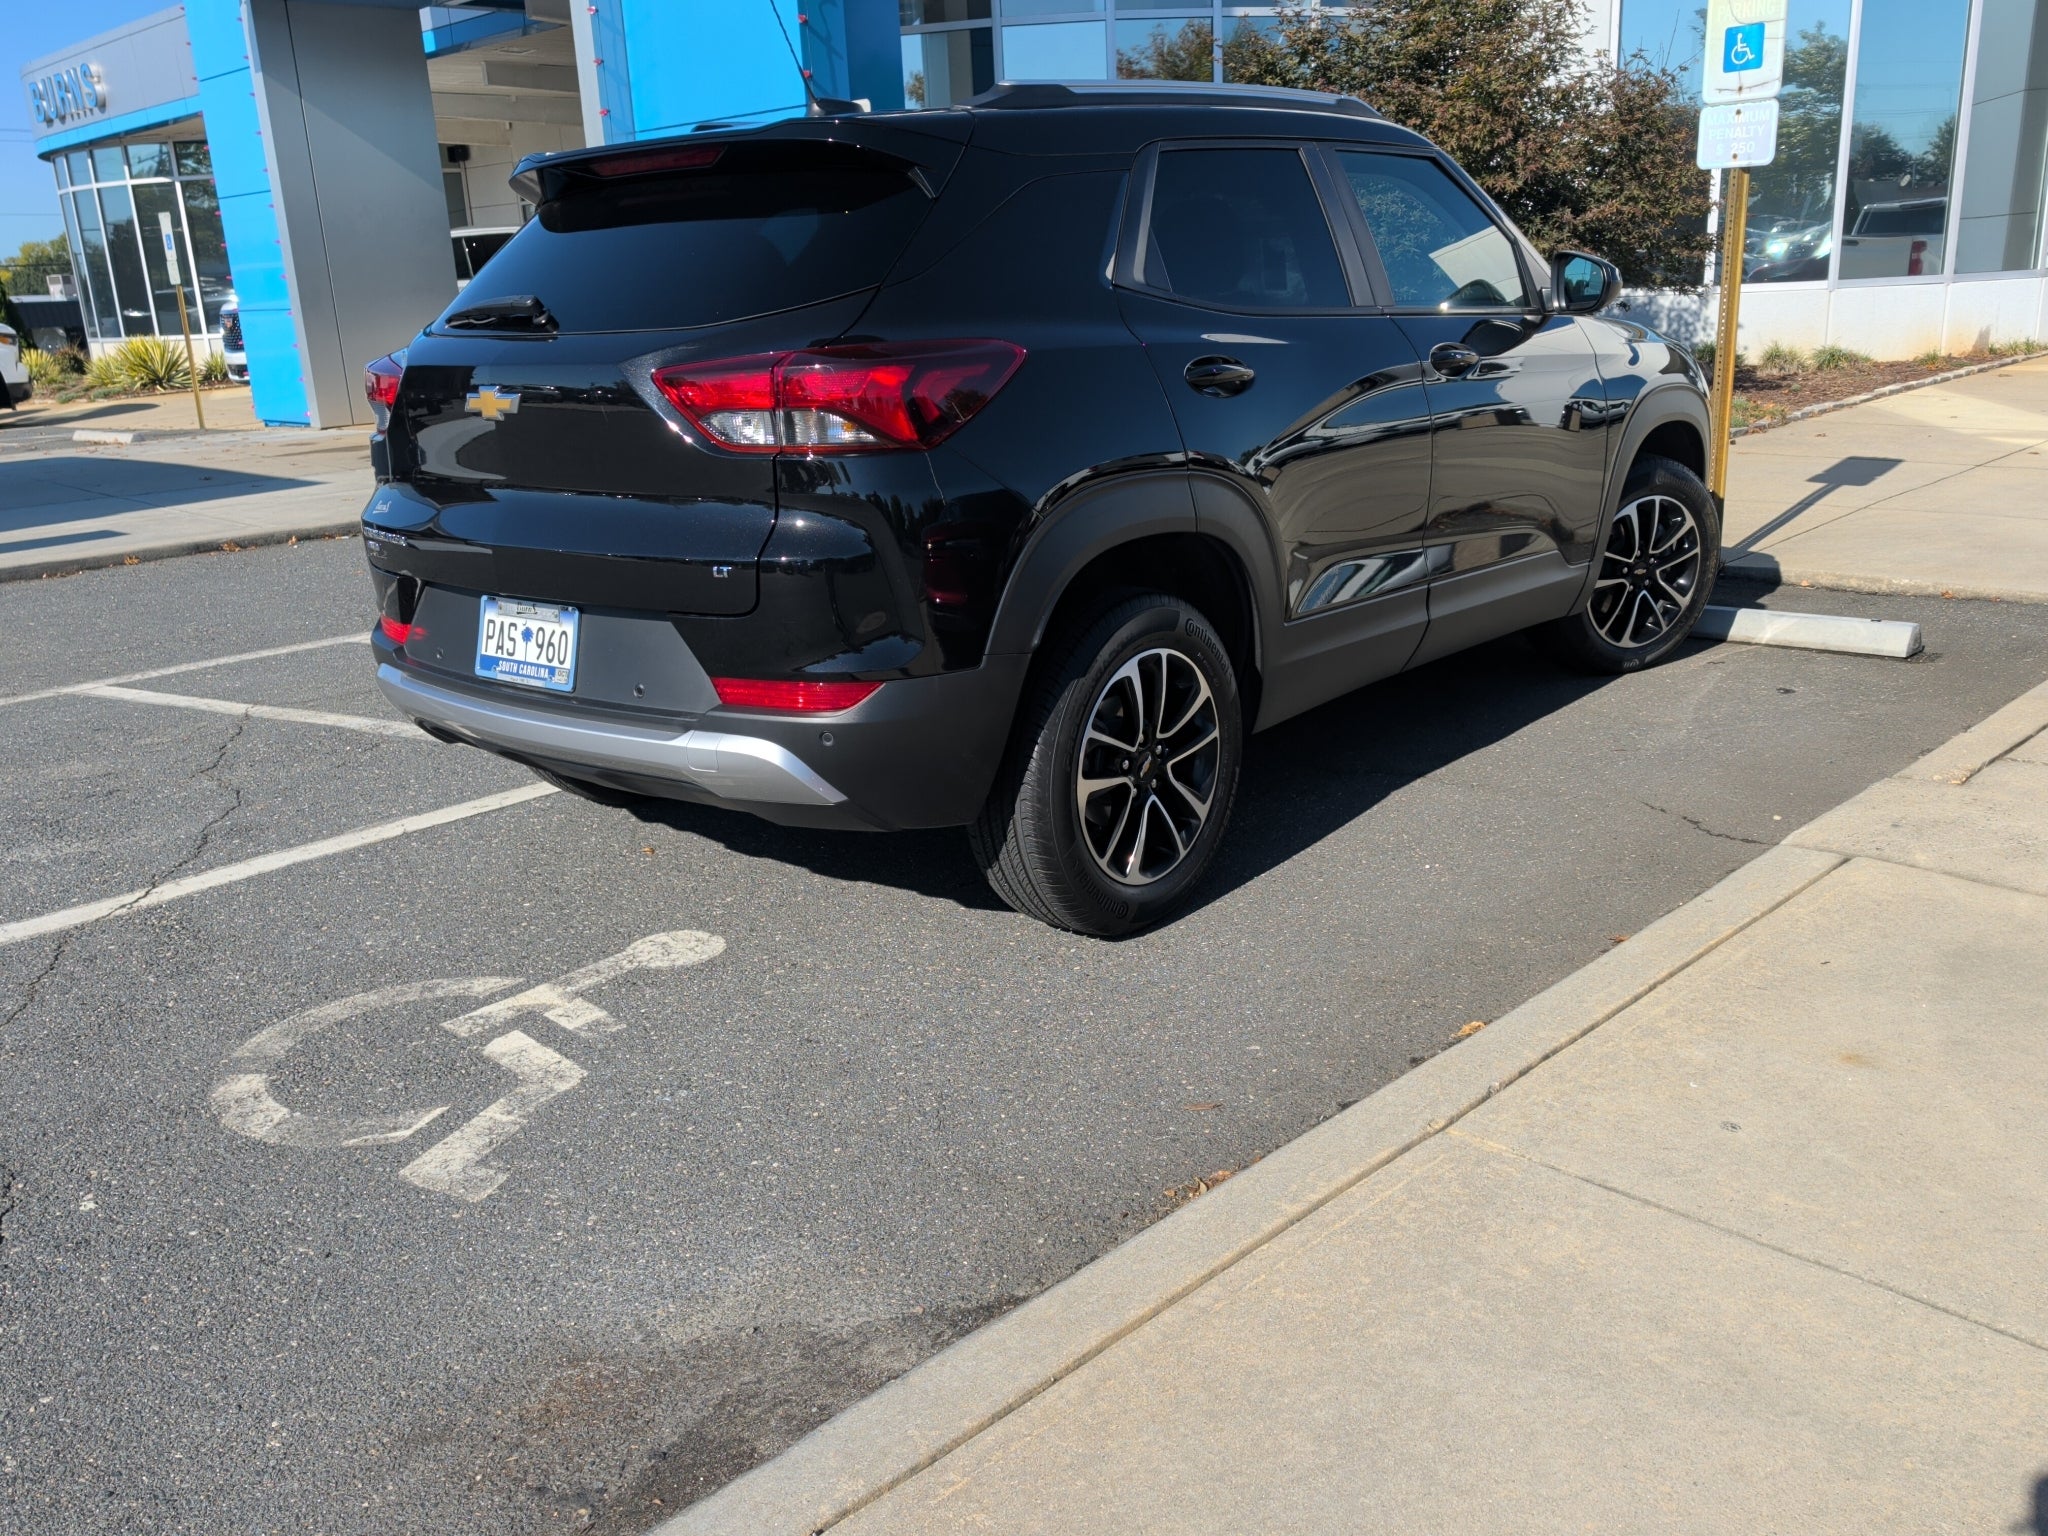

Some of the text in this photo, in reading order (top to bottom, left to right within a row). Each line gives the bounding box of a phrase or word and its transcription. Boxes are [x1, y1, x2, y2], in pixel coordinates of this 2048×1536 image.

[28, 62, 98, 123] BURNS
[1707, 109, 1771, 125] MAXIMUM
[1708, 125, 1766, 140] PENALTY
[1730, 141, 1756, 154] 250
[712, 566, 732, 578] LT
[484, 619, 568, 666] PAS 960
[1185, 617, 1230, 677] Continental
[498, 660, 549, 678] SOUTH CAROLINA
